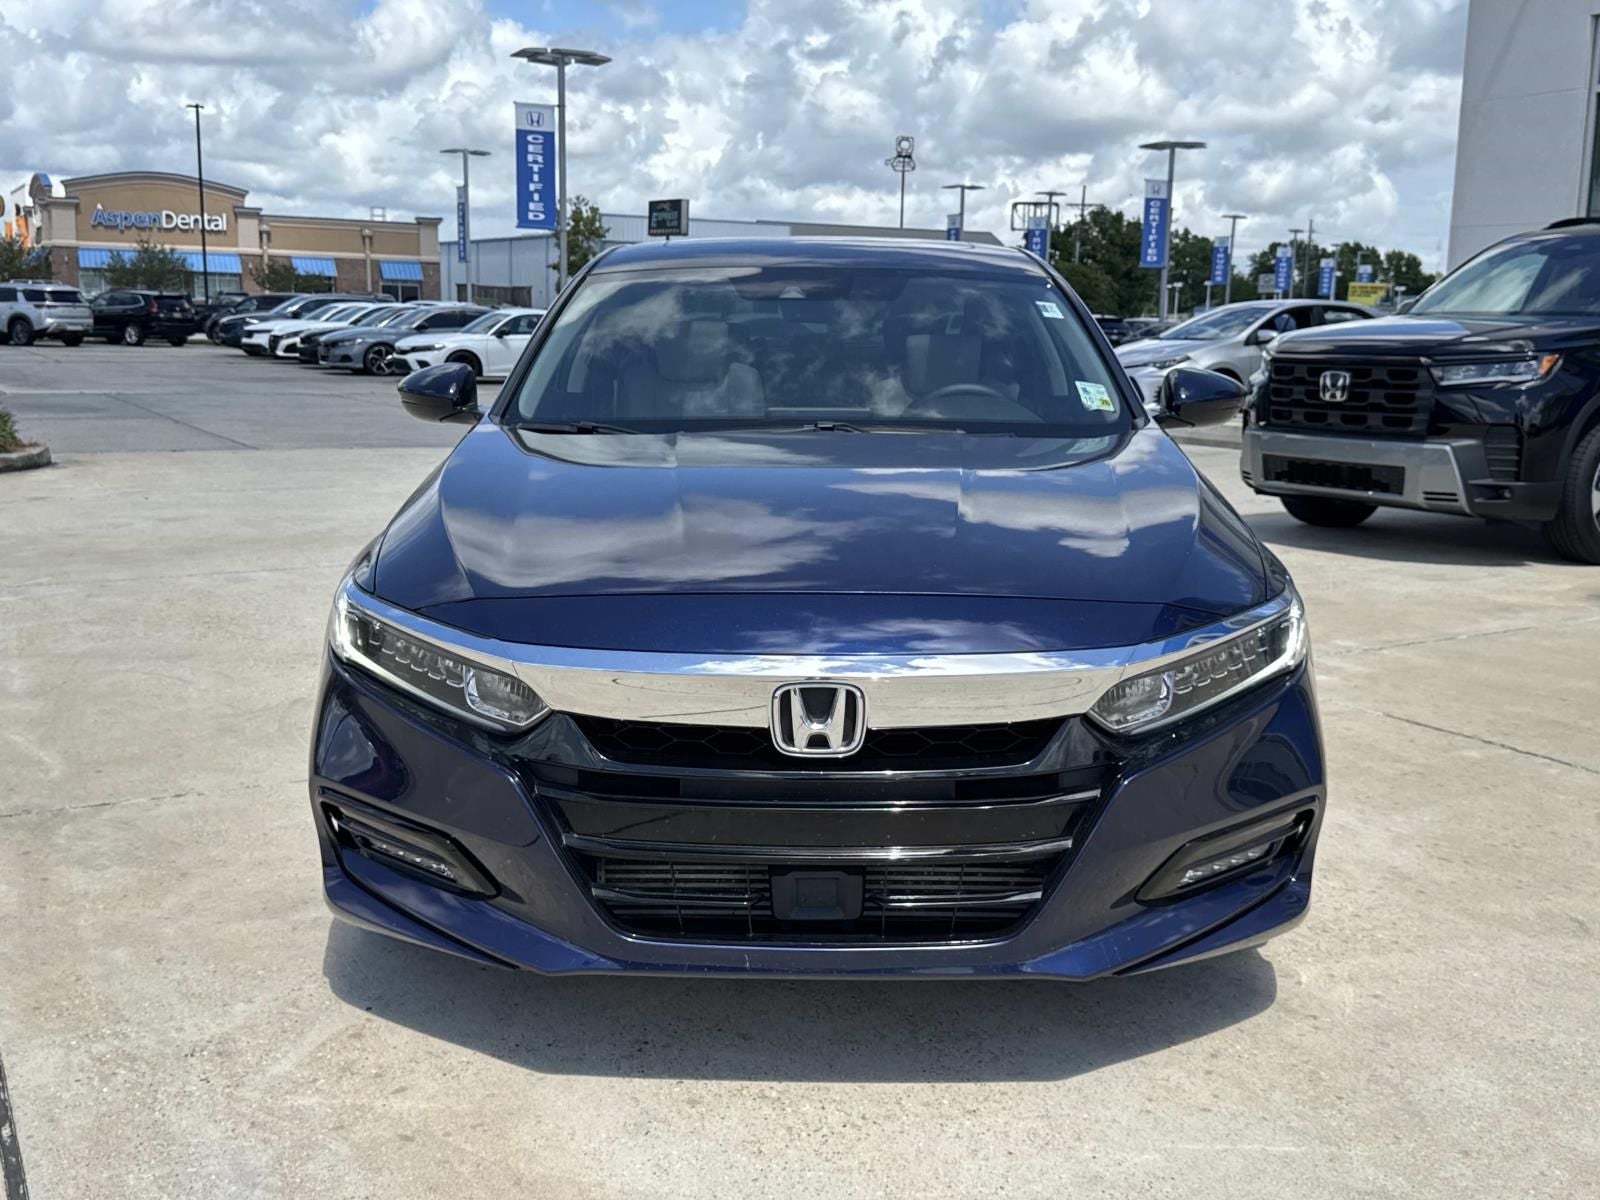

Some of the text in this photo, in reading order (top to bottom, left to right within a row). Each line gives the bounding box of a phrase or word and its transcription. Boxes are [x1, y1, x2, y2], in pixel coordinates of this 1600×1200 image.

[527, 134, 545, 220] CERTIFIED
[92, 202, 227, 231] AspenDental
[1146, 200, 1160, 262] CERTIFIED
